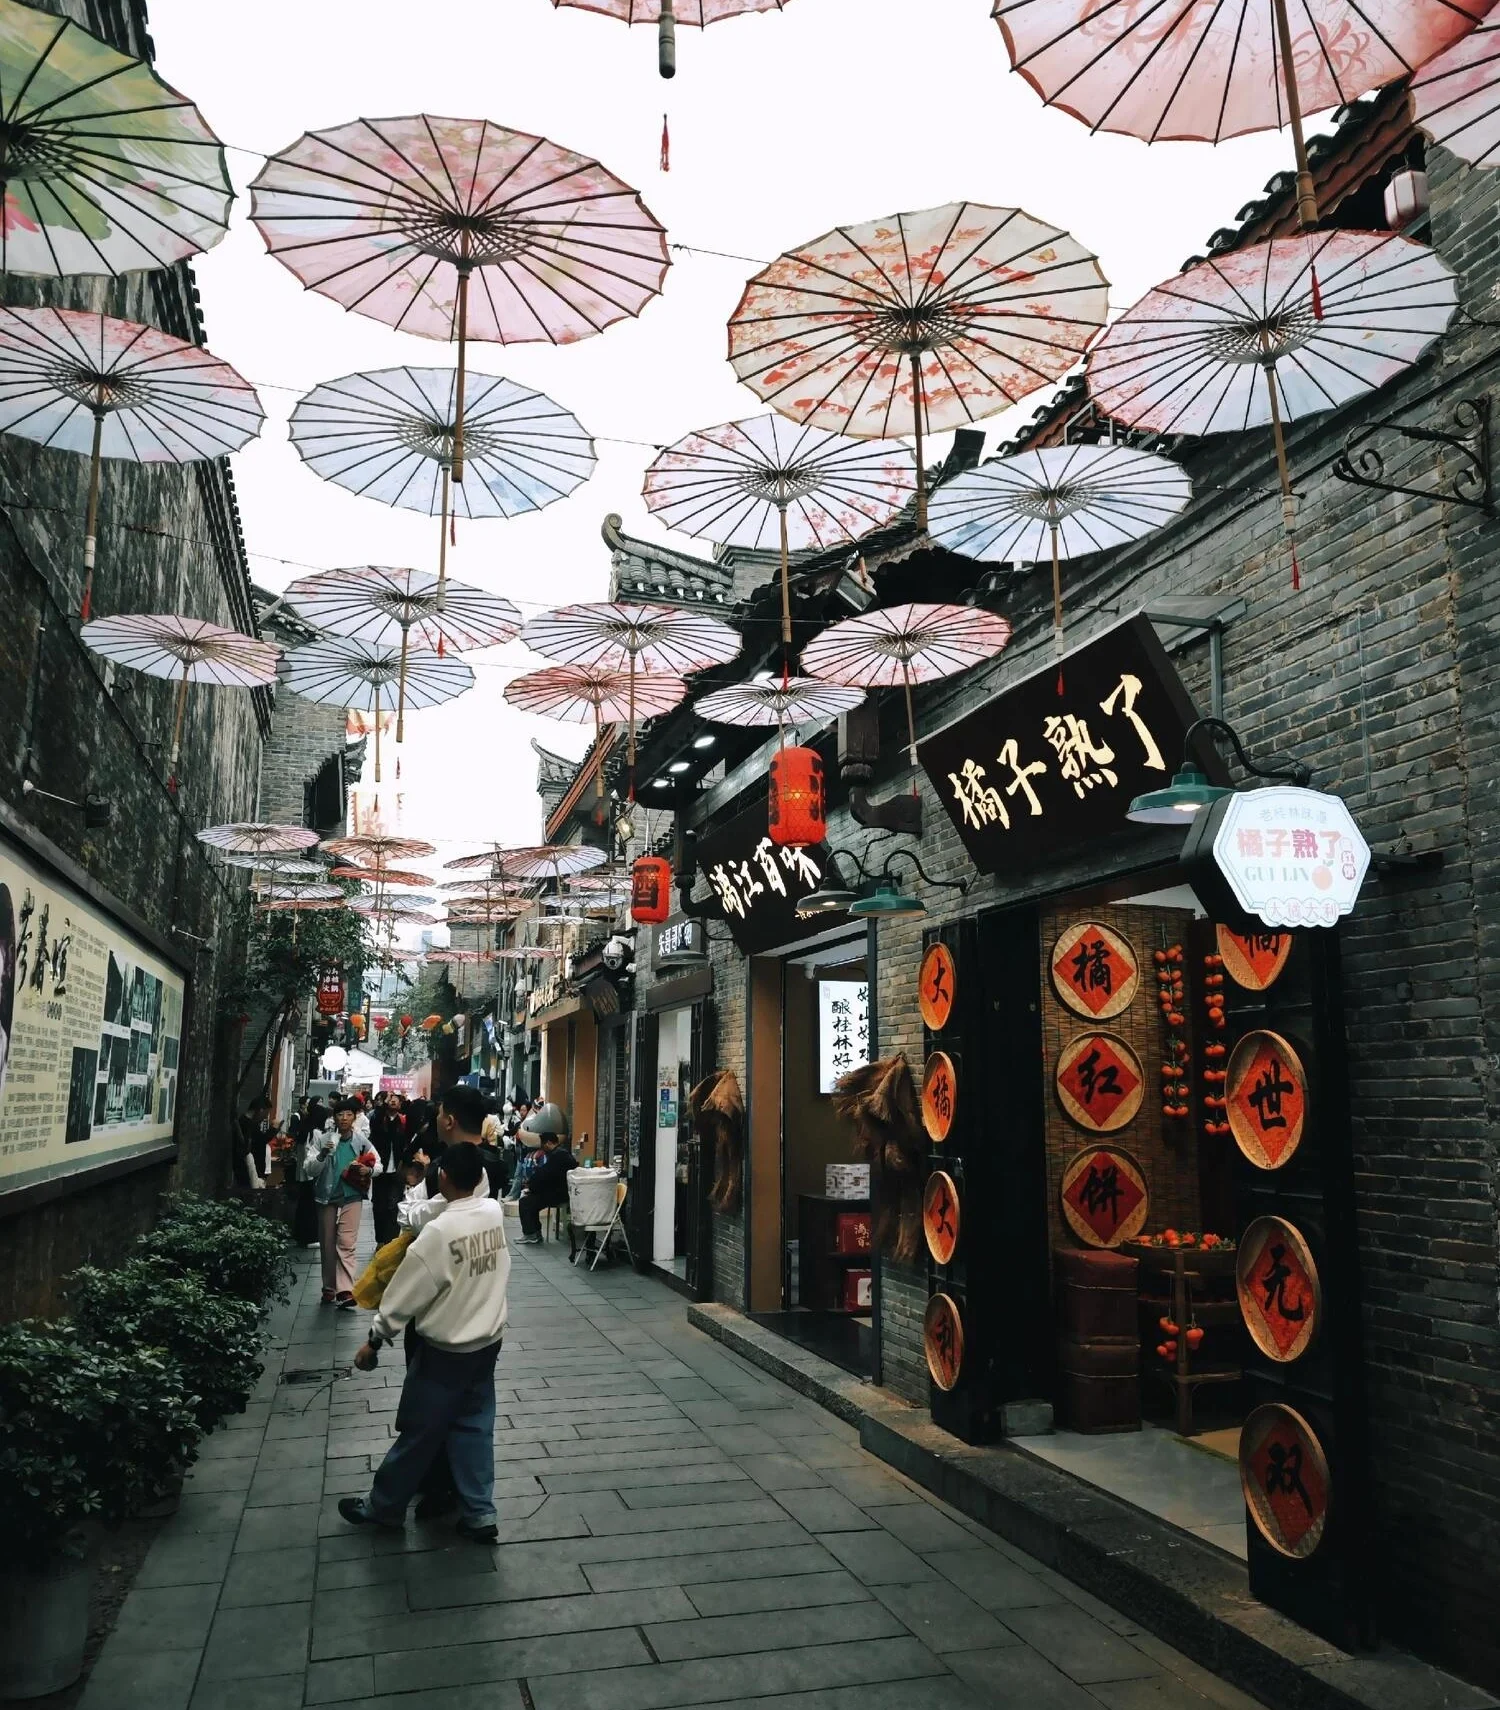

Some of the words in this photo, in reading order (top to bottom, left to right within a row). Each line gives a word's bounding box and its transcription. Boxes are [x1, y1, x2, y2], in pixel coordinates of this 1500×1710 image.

[947, 674, 1167, 830] 橘子熟了
[709, 836, 822, 919] 漓江百味
[1236, 827, 1342, 859] 橘子熟了
[1072, 939, 1125, 1224] 橘红饼
[448, 1231, 481, 1265] STAY
